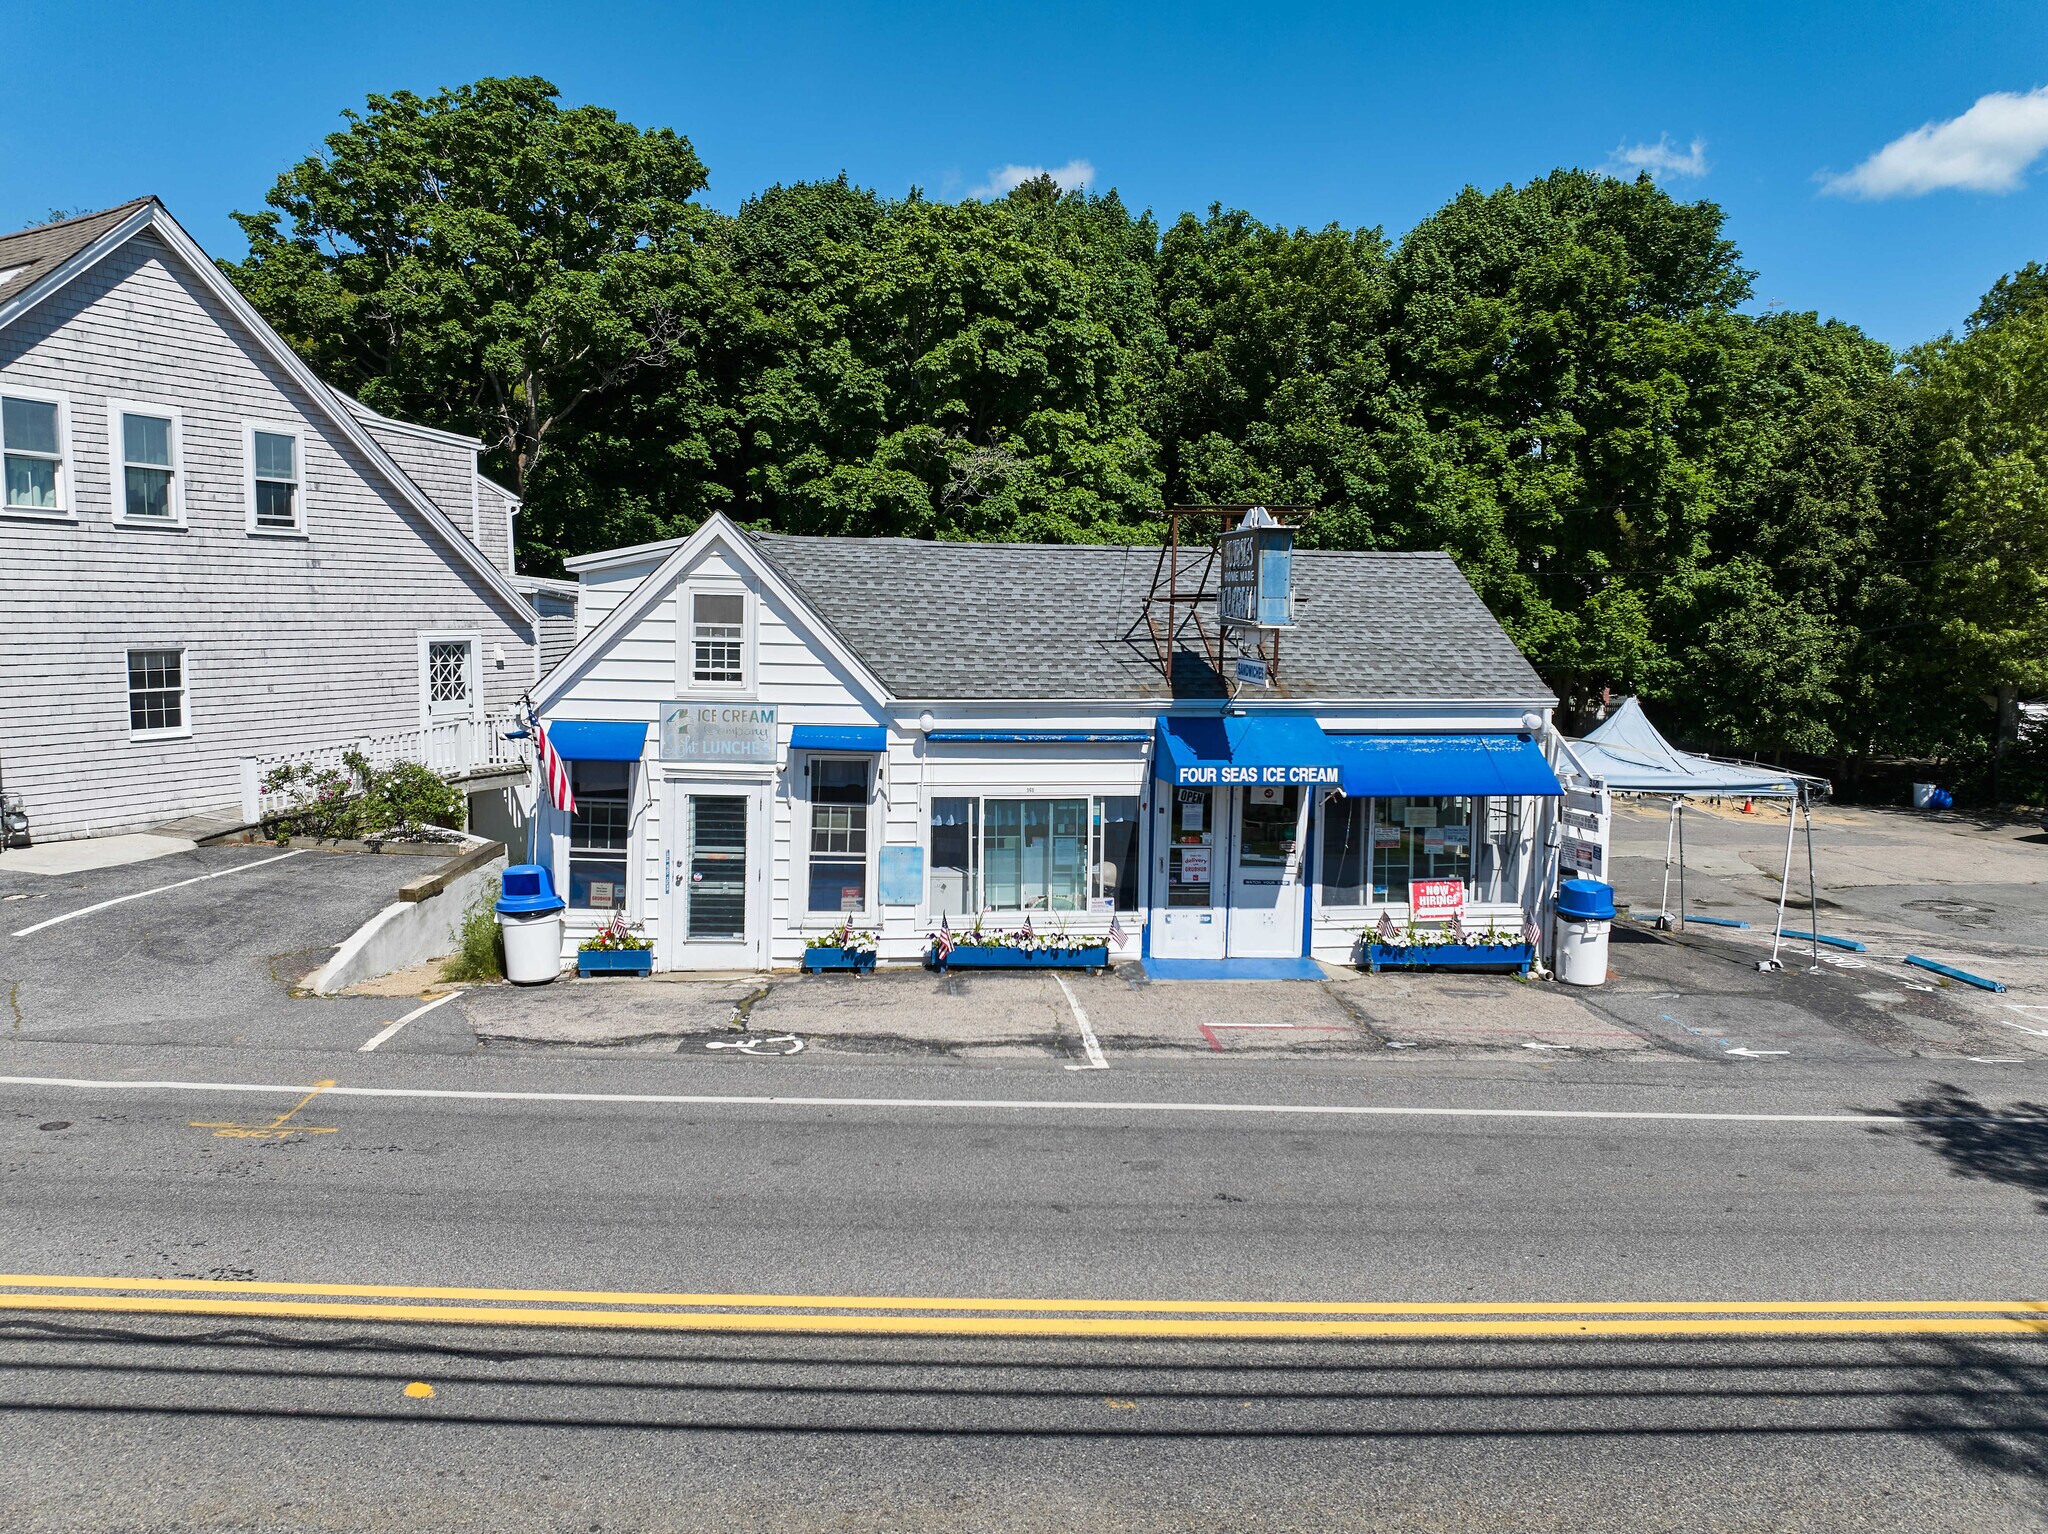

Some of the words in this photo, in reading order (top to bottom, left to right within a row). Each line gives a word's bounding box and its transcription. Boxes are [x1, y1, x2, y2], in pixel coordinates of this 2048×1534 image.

[1240, 570, 1255, 581] MADE
[1237, 662, 1264, 681] SANDWICHES
[697, 709, 717, 723] ICE
[721, 709, 775, 723] CREAM
[703, 725, 769, 741] Company
[702, 740, 769, 755] LUNCHES
[1179, 767, 1217, 783] FOUR
[1221, 767, 1258, 783] SEAS
[1262, 767, 1286, 783] ICE
[1289, 767, 1339, 783] CREAM
[1180, 790, 1204, 805] OPEN
[1184, 857, 1207, 865] delivery
[1425, 885, 1450, 896] NOW
